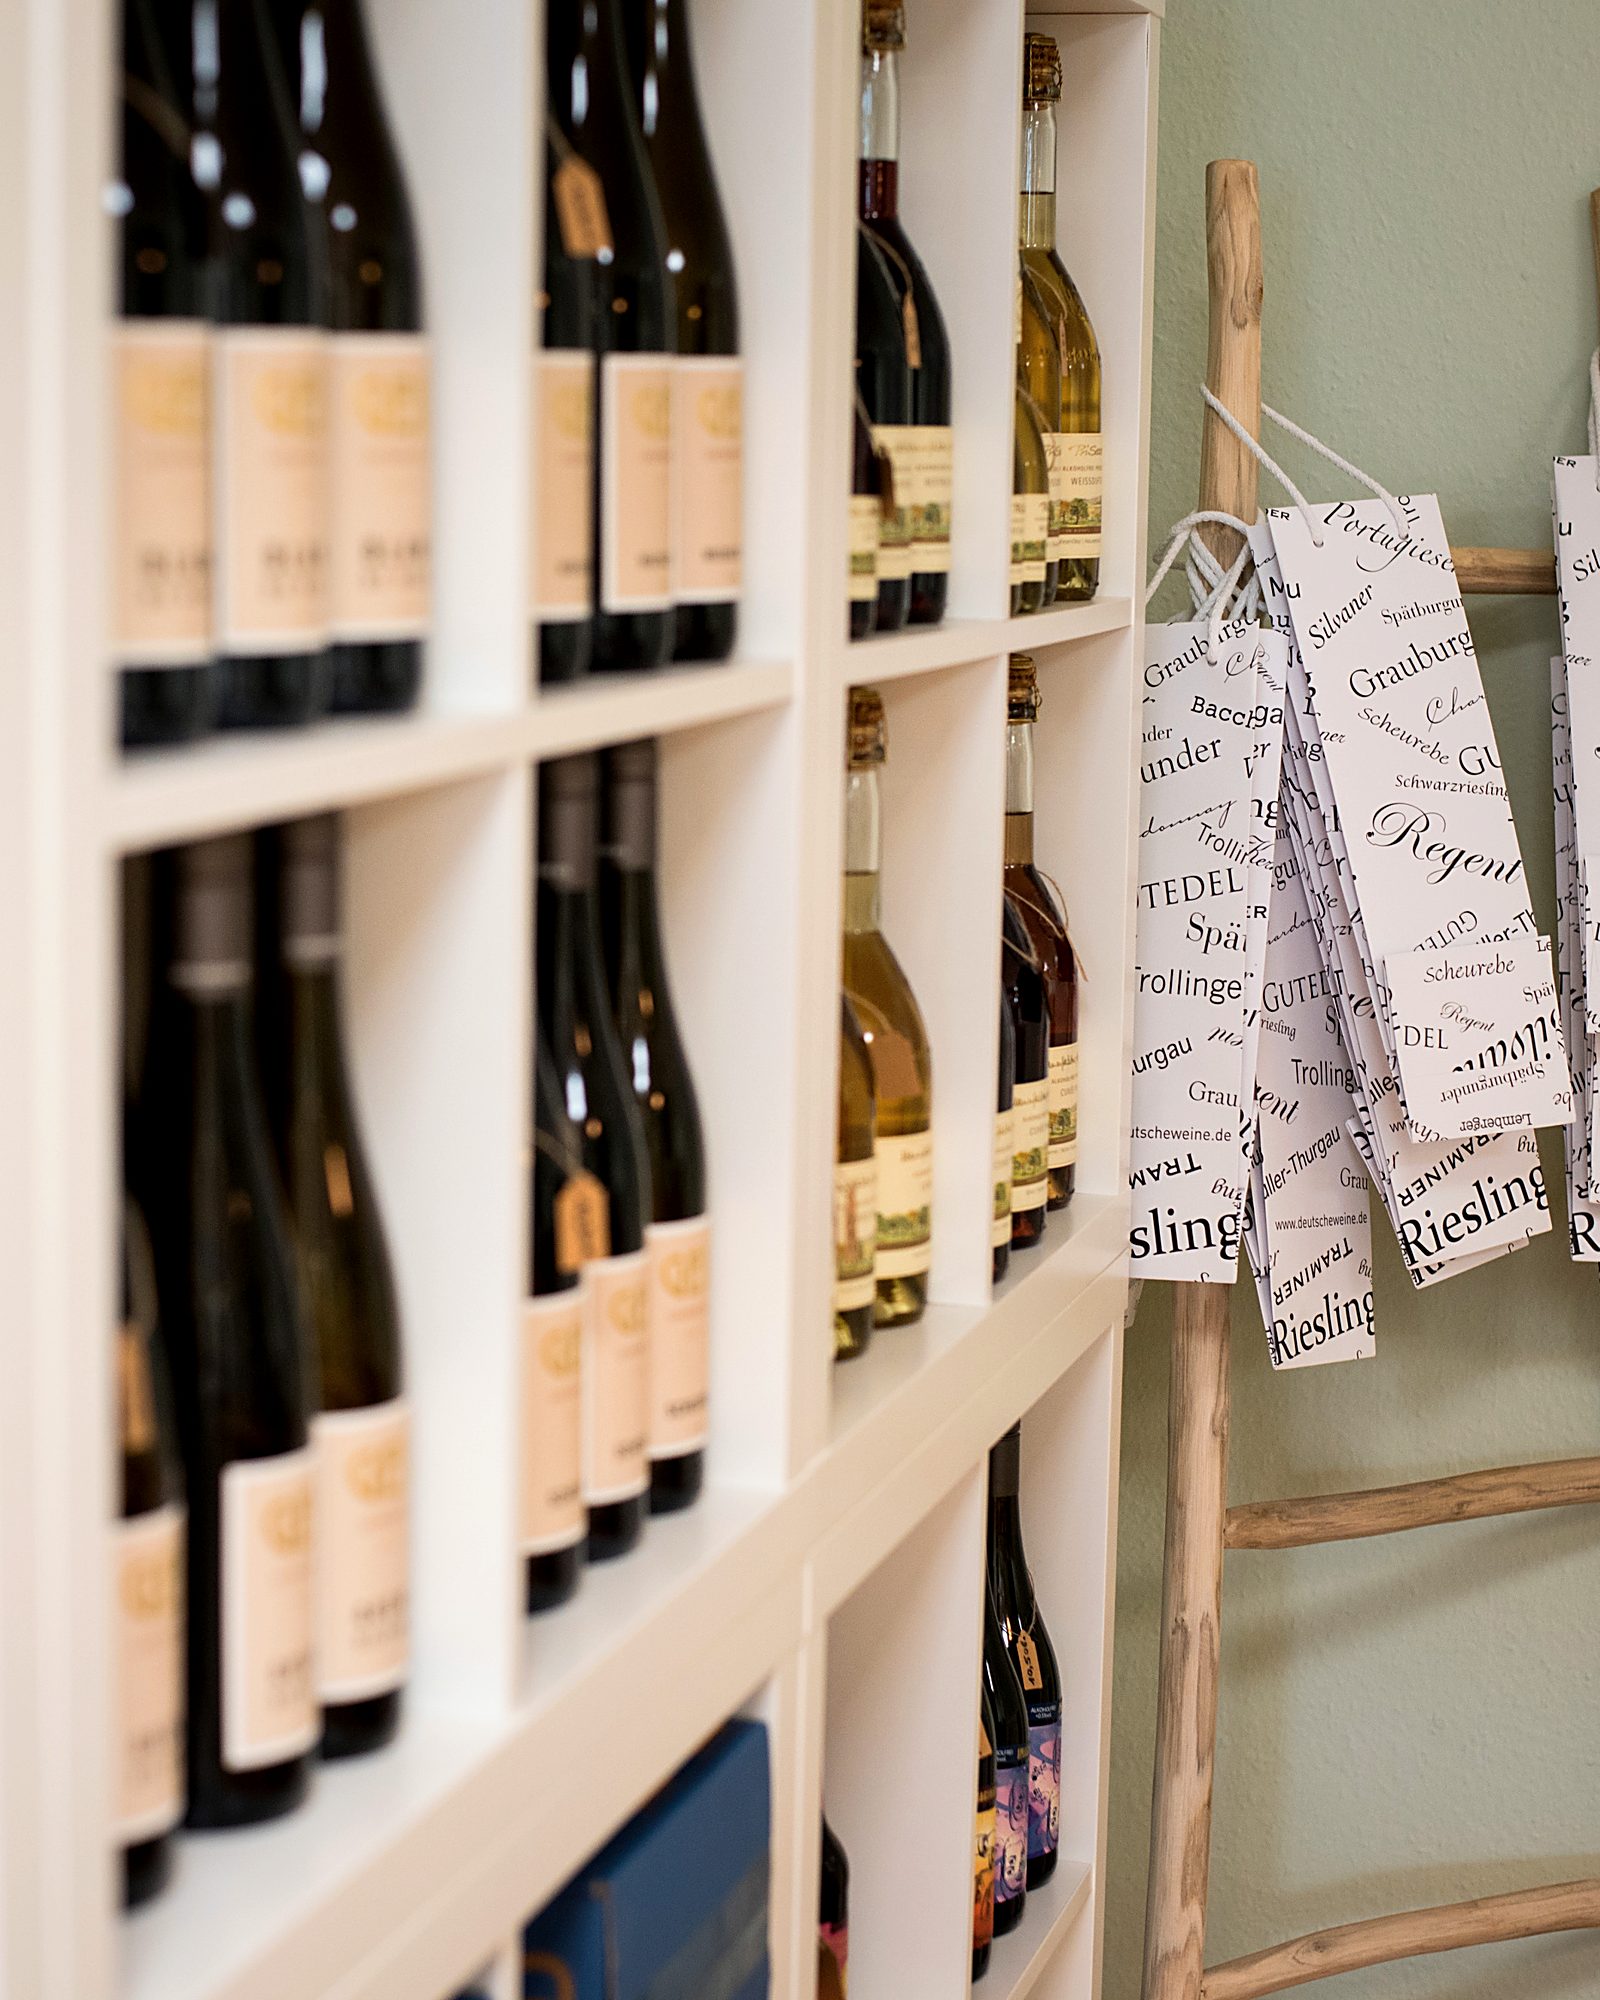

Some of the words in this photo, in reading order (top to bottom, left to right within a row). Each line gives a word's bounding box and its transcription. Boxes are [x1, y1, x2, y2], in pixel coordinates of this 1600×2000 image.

[1308, 584, 1373, 649] Silvaner
[1357, 707, 1450, 765] Scheurebe
[1366, 802, 1523, 885] Regent
[1135, 966, 1242, 1005] rollinge
[1424, 953, 1516, 983] Scheurebe
[1440, 1001, 1495, 1033] Regent
[1132, 1037, 1193, 1076] urgau
[1404, 1025, 1448, 1050] DEL
[1440, 1062, 1545, 1104] Spätburgunder
[1459, 1113, 1533, 1132] Lemberger
[1275, 1211, 1368, 1231] www.deutscheweine.de
[1274, 1238, 1353, 1306] TRAMINER
